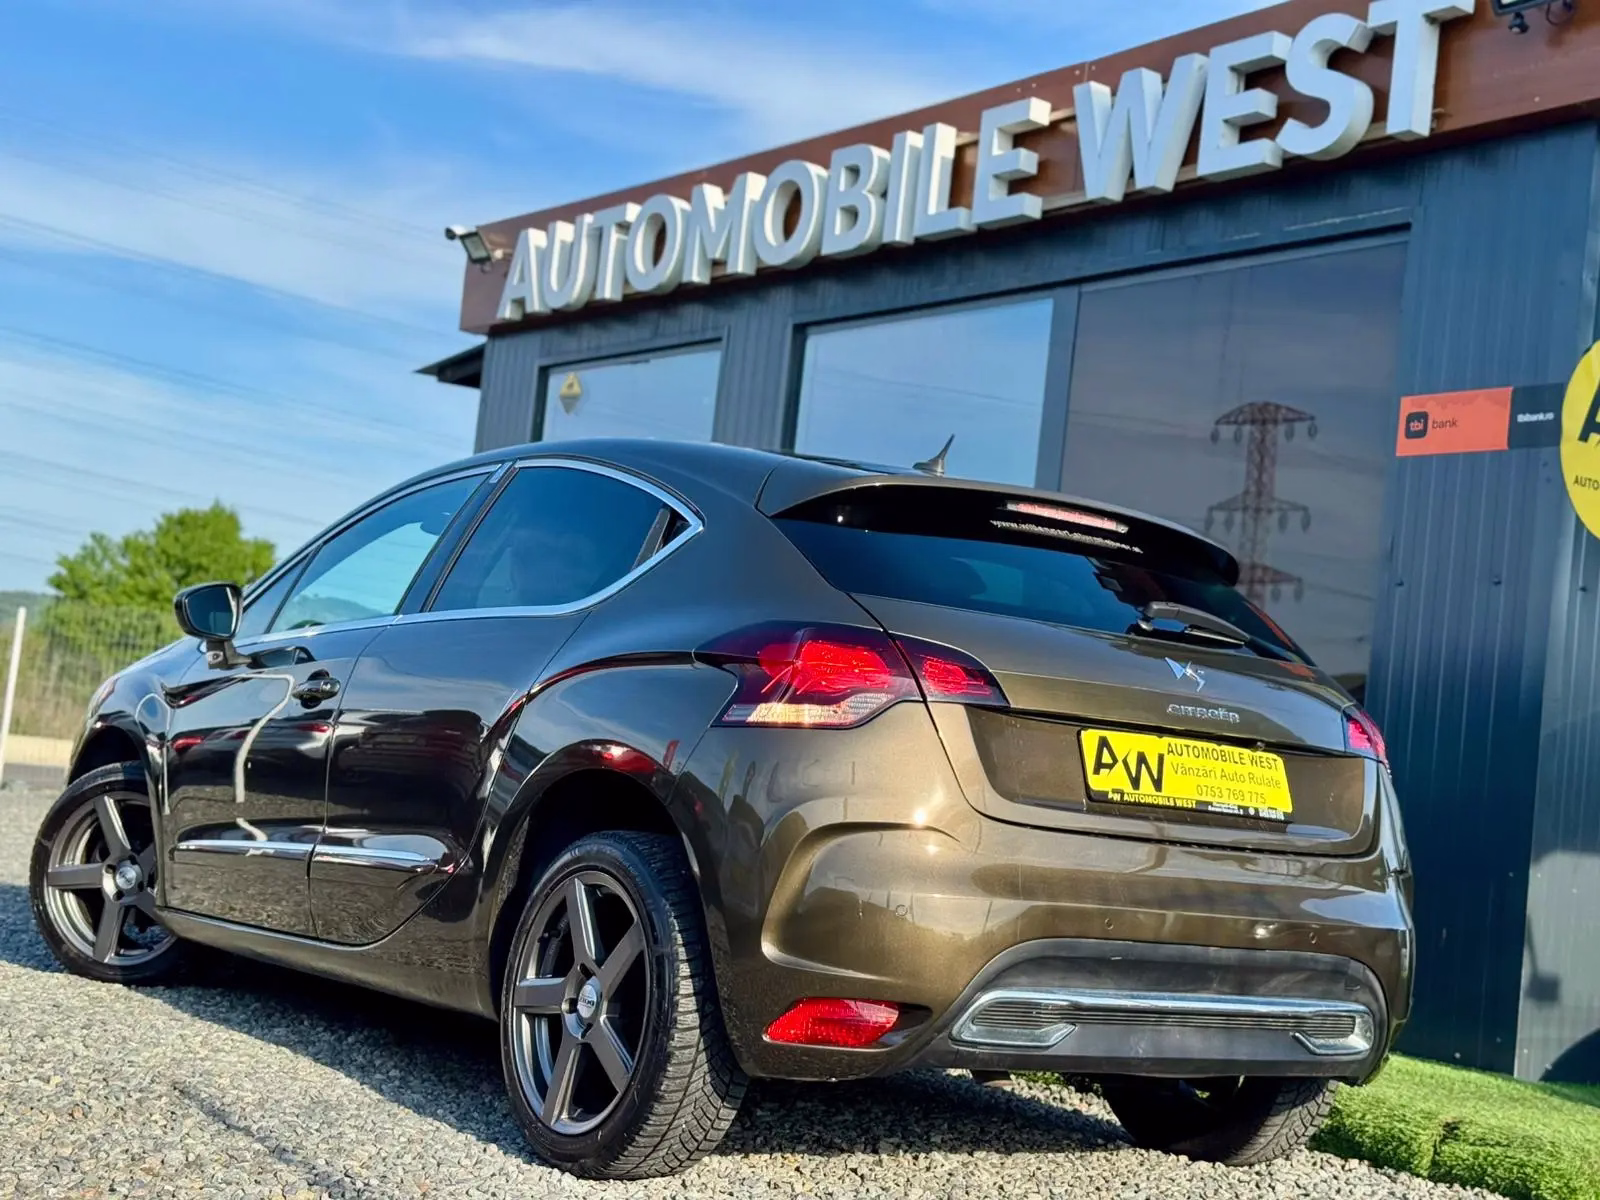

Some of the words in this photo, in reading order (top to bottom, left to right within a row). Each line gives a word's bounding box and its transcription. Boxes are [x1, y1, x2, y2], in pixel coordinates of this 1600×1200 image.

[496, 97, 1052, 321] AUTOMOBILE
[1073, 0, 1476, 202] WEST
[1431, 417, 1459, 430] bank
[1166, 742, 1247, 766] AUTOMOBILE
[1247, 753, 1279, 772] WEST
[1219, 768, 1246, 784] Auto
[1247, 771, 1282, 790] Rulate
[1123, 793, 1175, 806] AUTOMOBILE
[1175, 798, 1197, 808] WEST
[1196, 784, 1224, 799] 0753
[1225, 788, 1246, 801] 769
[1247, 791, 1267, 805] 775
